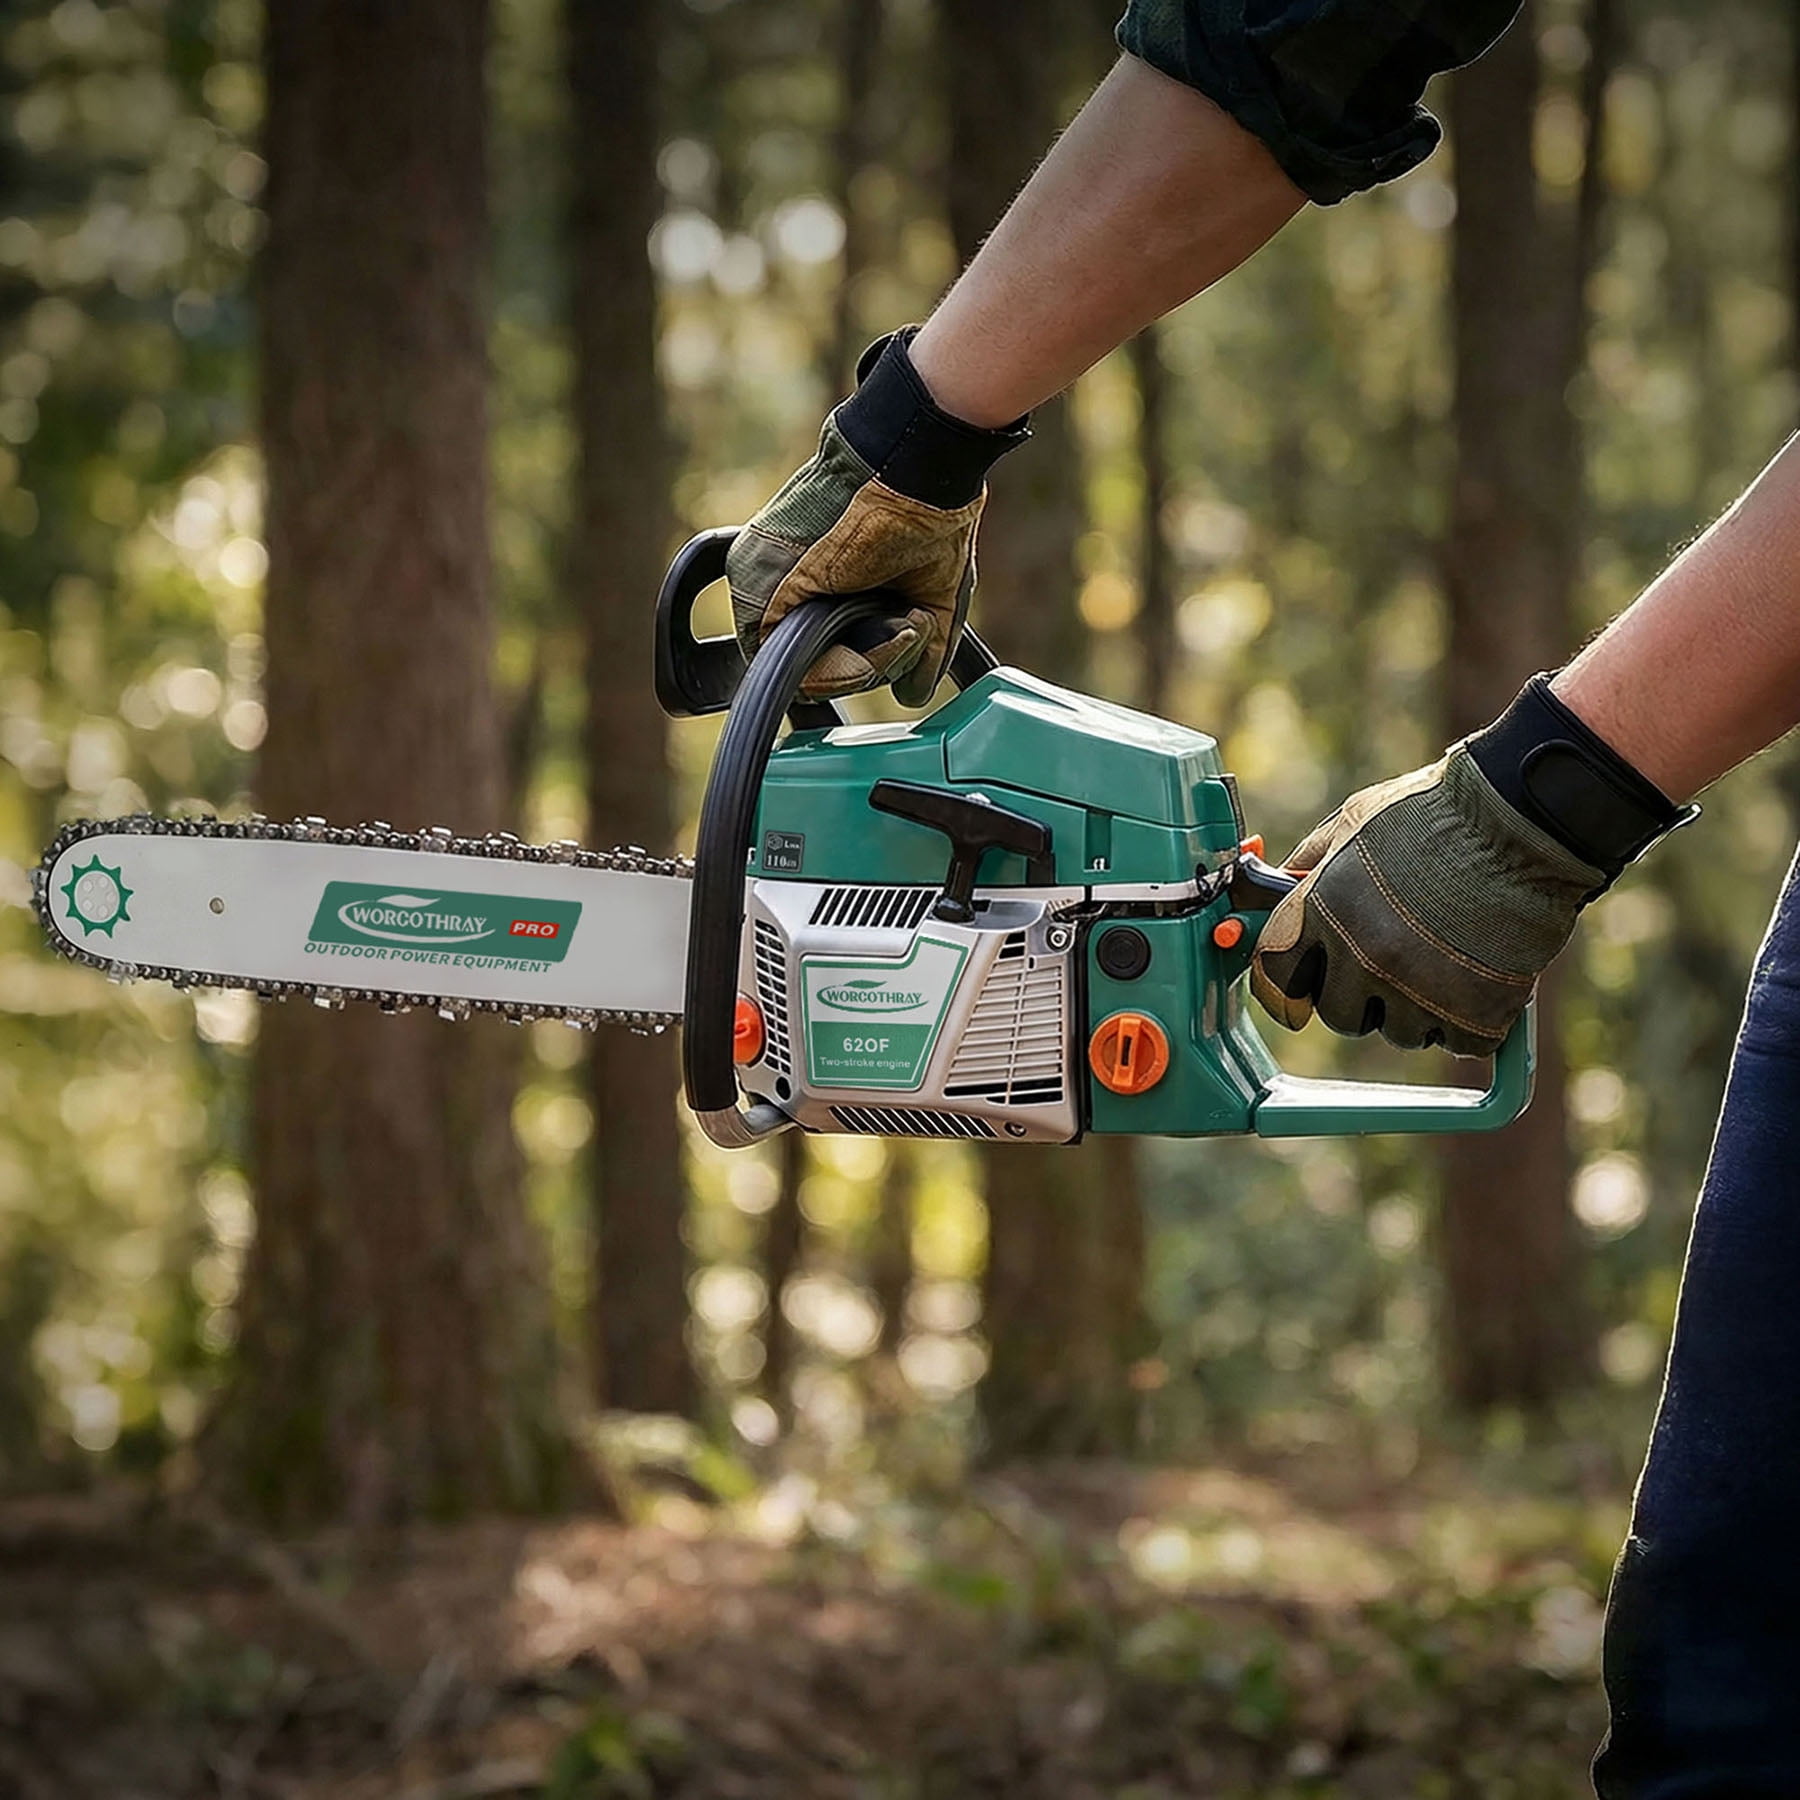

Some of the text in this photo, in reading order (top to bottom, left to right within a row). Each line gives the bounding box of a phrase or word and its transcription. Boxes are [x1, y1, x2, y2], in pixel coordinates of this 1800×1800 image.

[352, 907, 487, 933] WORCOTHRAY
[513, 922, 555, 936] PRO
[304, 942, 552, 973] OUTDOOR POWER EQUIPMENT
[826, 990, 922, 1004] WORCOTHRAY
[820, 1057, 911, 1070] Two-stroke engine
